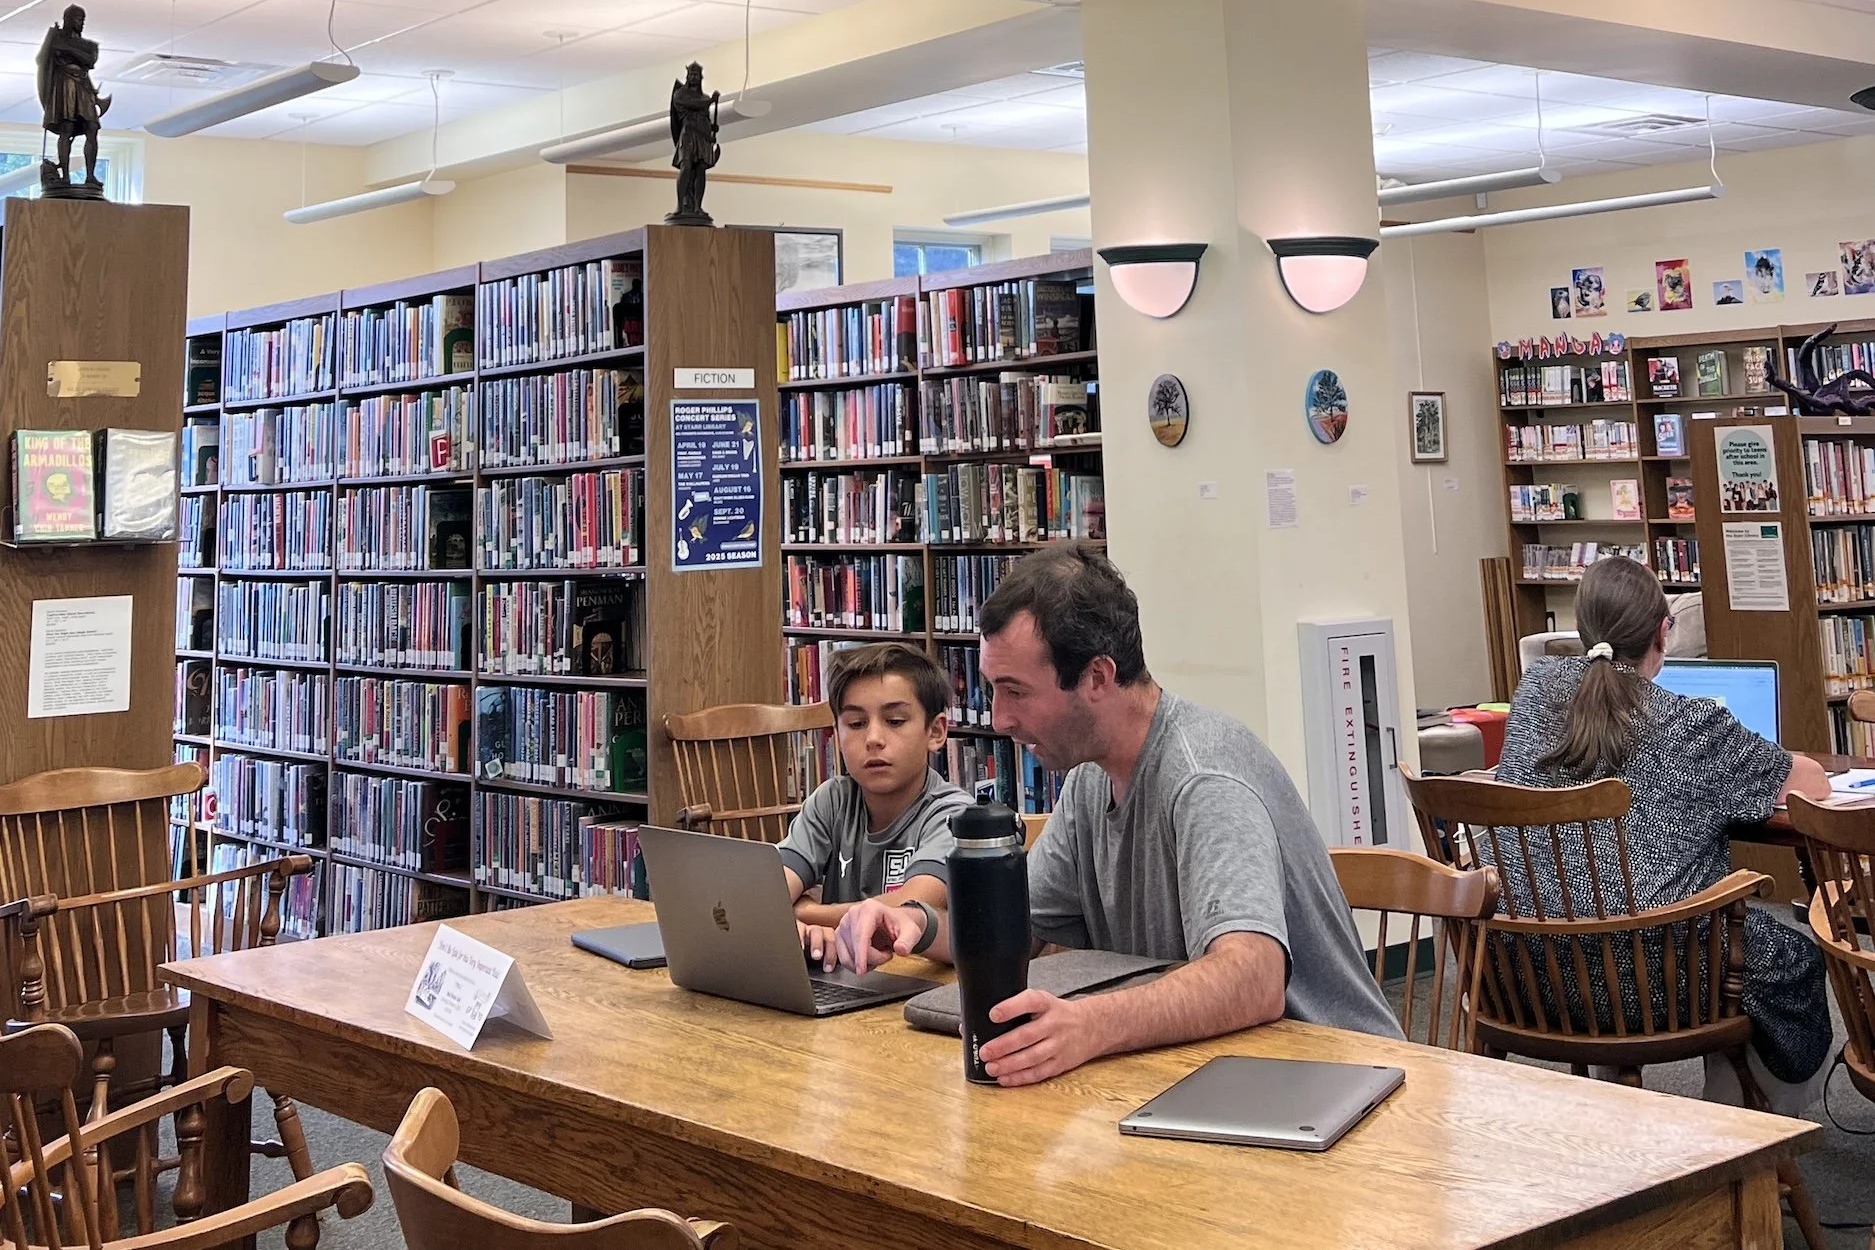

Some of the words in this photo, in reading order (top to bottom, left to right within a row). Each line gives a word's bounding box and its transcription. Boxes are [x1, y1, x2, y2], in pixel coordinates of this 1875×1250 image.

[694, 373, 736, 384] FICTION
[675, 414, 709, 422] CONCERT
[24, 437, 48, 450] KING
[53, 437, 64, 450] OF
[72, 437, 91, 450] THE
[23, 454, 92, 467] ARMADILLOS
[705, 553, 726, 561] 2025
[727, 551, 757, 560] SEASON
[576, 594, 623, 607] PENMAN
[1340, 647, 1352, 690] FIRE
[1345, 707, 1362, 845] EXTINGUISHE
